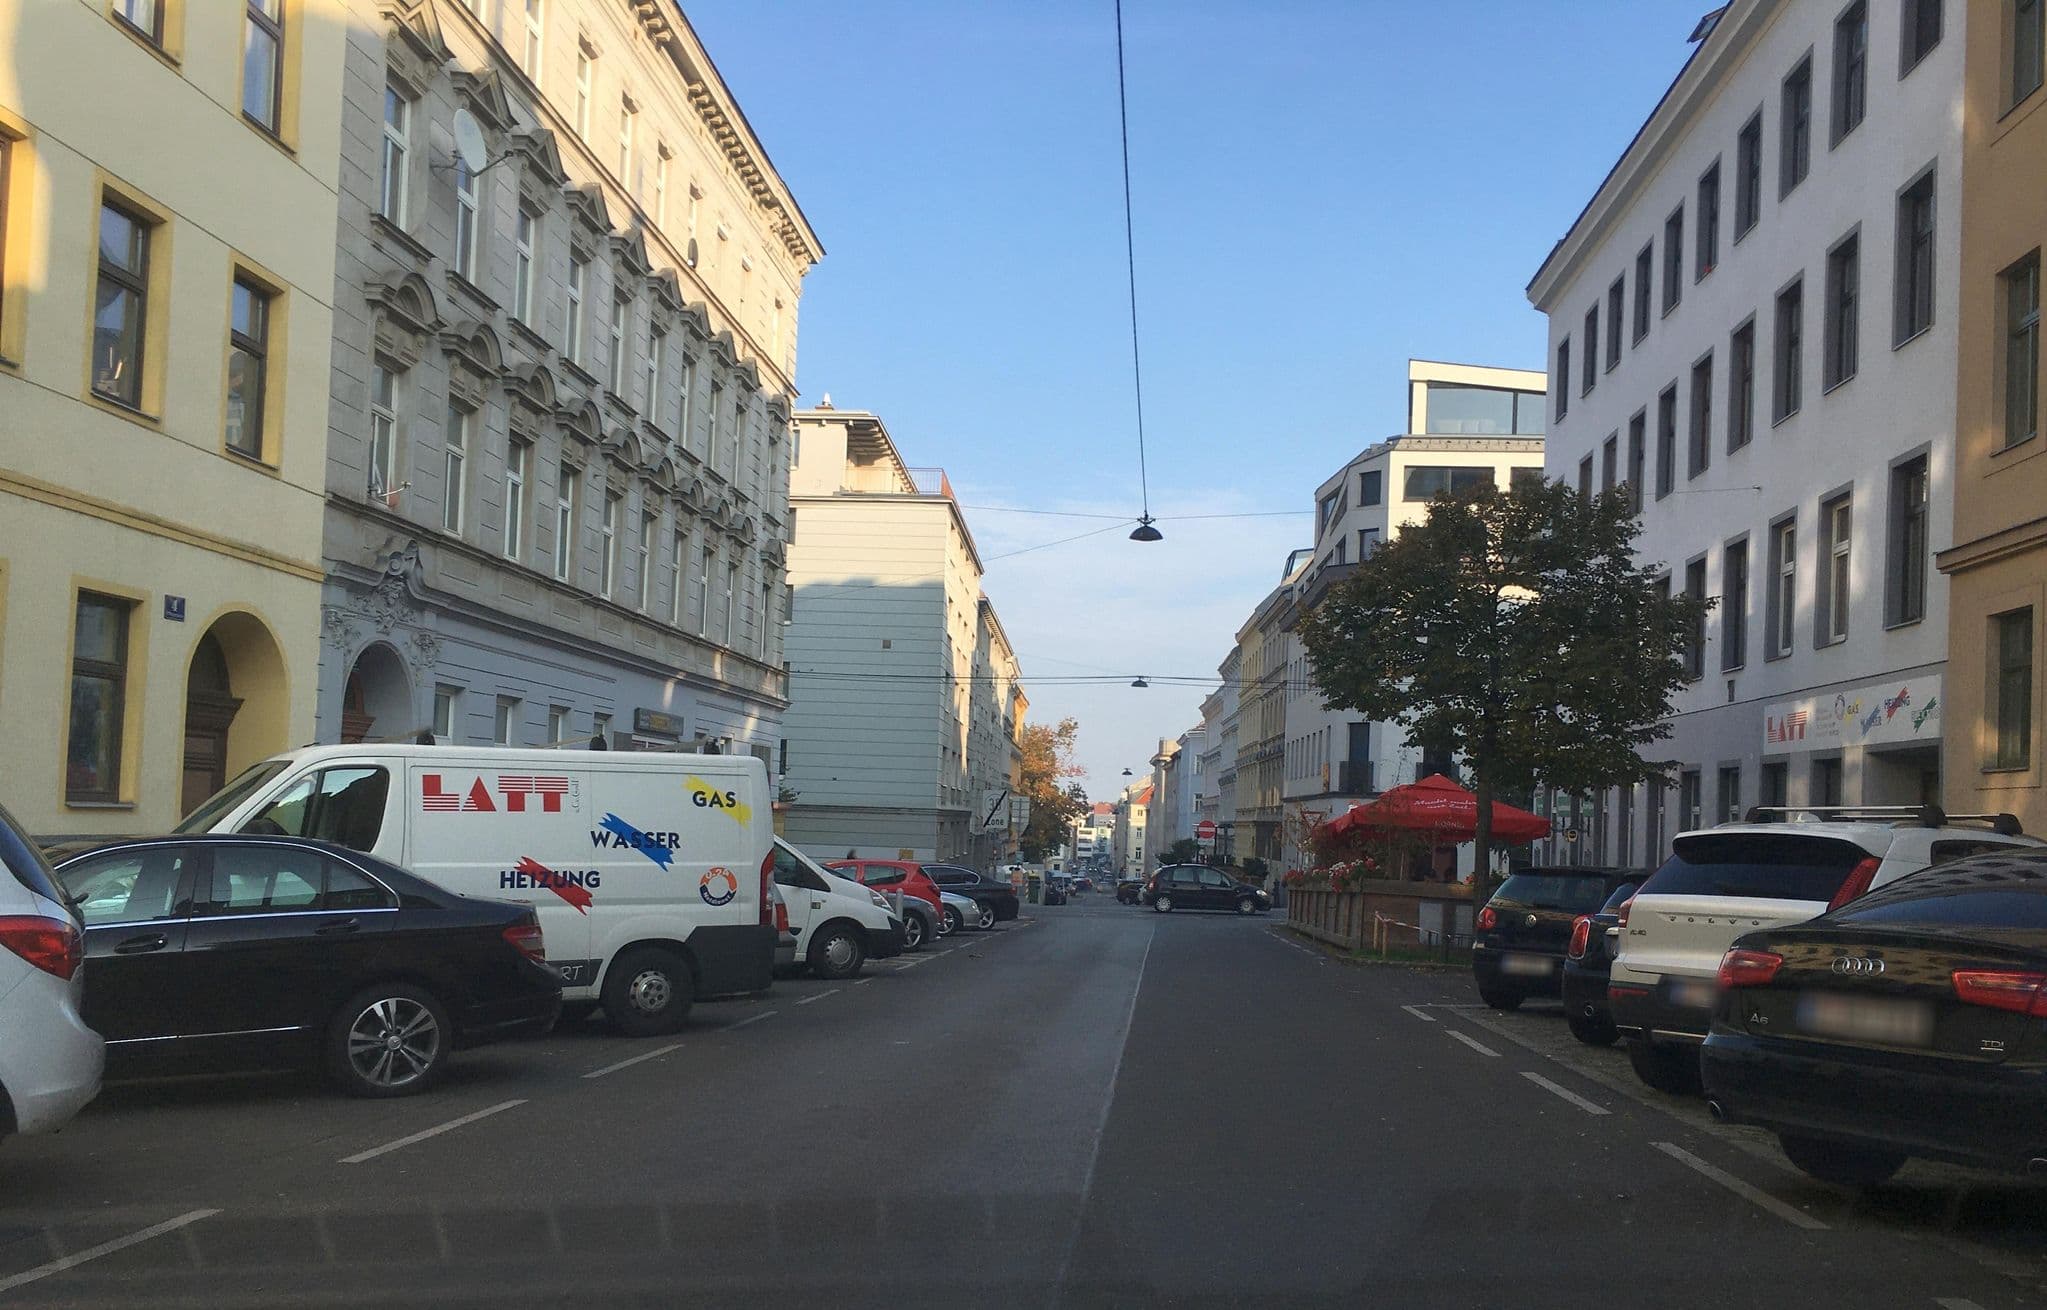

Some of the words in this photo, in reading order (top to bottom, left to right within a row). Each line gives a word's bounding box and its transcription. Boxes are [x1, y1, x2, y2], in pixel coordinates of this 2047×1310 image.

[1847, 703, 1859, 715] GAS
[1767, 711, 1807, 743] LATT
[422, 774, 569, 813] LATT
[692, 790, 737, 808] GAS
[590, 830, 682, 849] WASSER
[499, 870, 601, 889] HEIZUNG
[1669, 915, 1760, 926] VOLVO
[1750, 1013, 1769, 1025] A6
[1981, 1040, 2004, 1048] TDI
